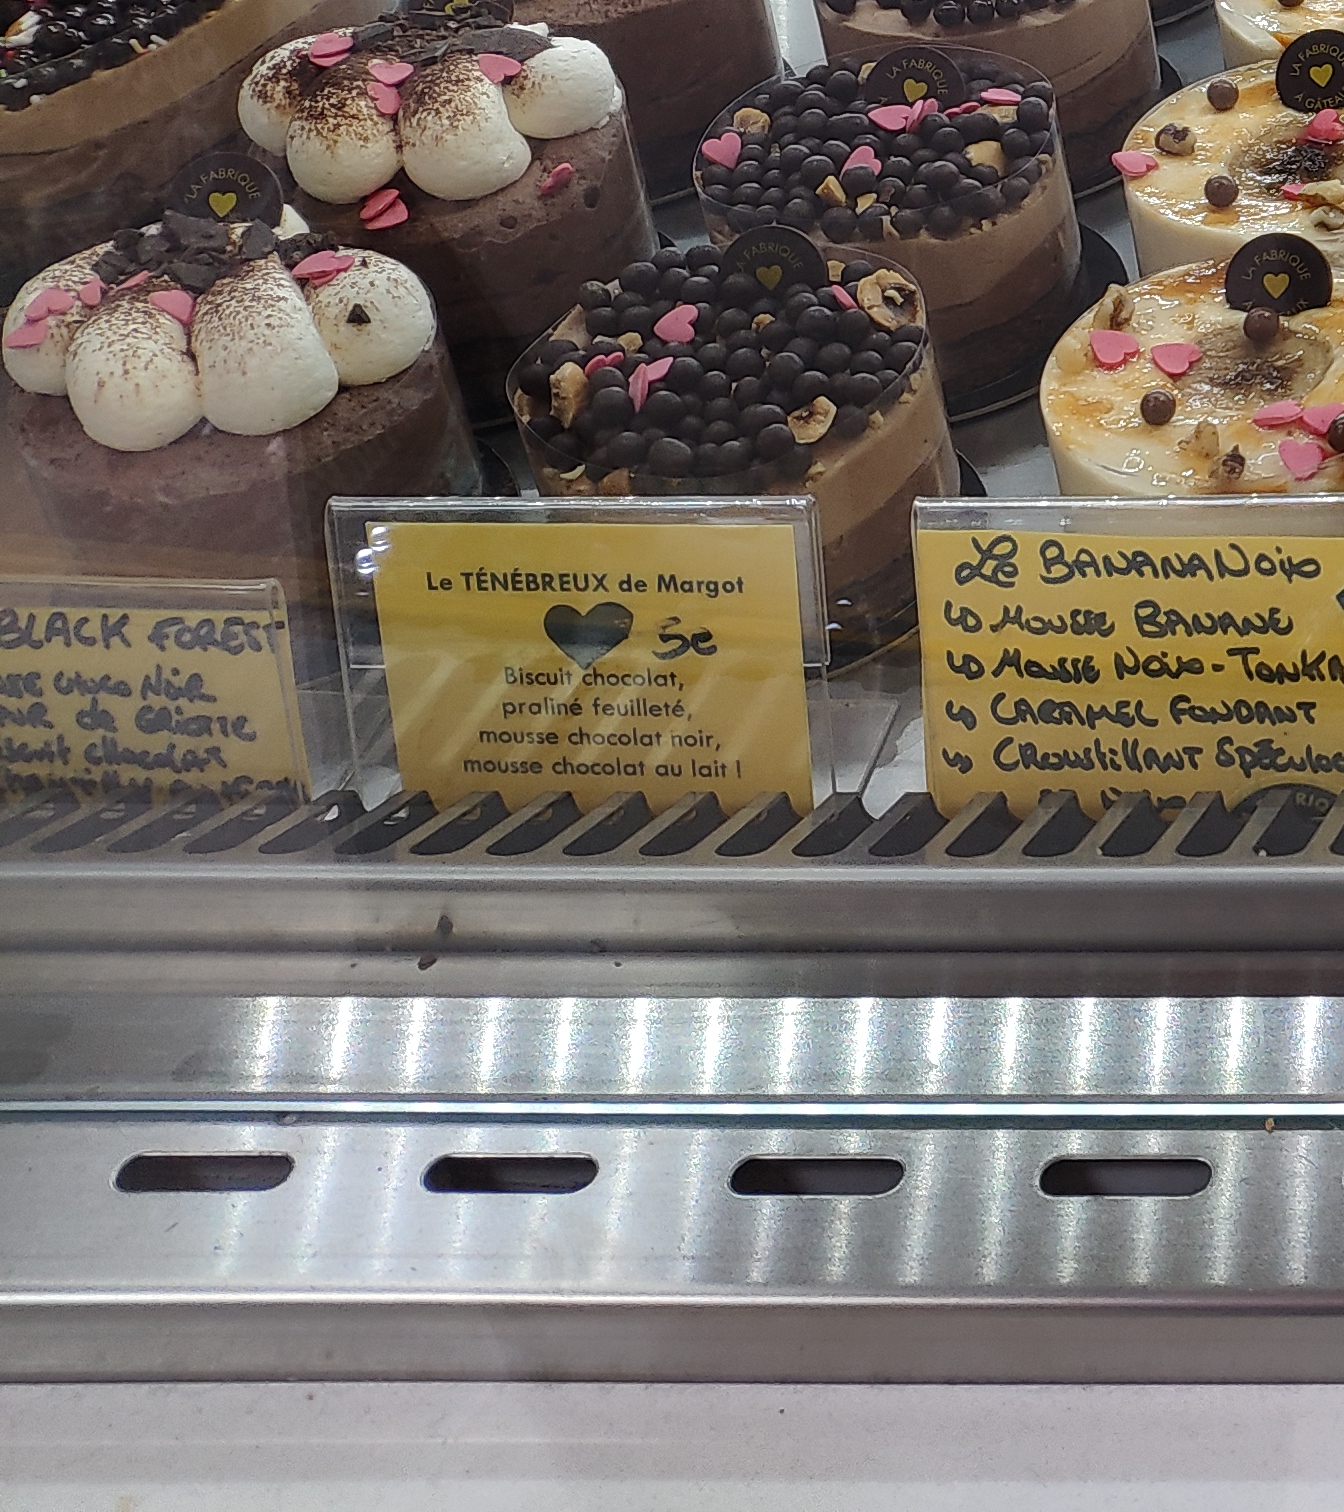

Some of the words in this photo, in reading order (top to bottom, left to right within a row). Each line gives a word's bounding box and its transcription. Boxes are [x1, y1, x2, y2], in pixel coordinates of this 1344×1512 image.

[884, 66, 901, 81] LA
[901, 58, 950, 96] FABRIQUE
[1289, 62, 1302, 78] LA
[187, 183, 199, 201] LA
[201, 167, 261, 200] FABRIQUE
[1241, 265, 1257, 282] LA
[1253, 249, 1312, 282] FABRIQUE
[426, 572, 452, 591] Le
[461, 567, 609, 593] TÉNÉBREUX
[618, 572, 648, 593] de
[657, 574, 744, 599] Margot
[148, 617, 285, 655] FOREST
[504, 666, 573, 687] Biscuit
[582, 667, 685, 692] chocolat,
[502, 697, 583, 719] praliné
[592, 696, 693, 721] feuilleté,
[479, 729, 559, 745] mousse
[568, 728, 662, 747] chocolat
[671, 729, 722, 751] noir,
[463, 758, 543, 774] mousse
[552, 757, 646, 776] chocolat
[655, 762, 683, 778] au
[691, 759, 727, 778] lait
